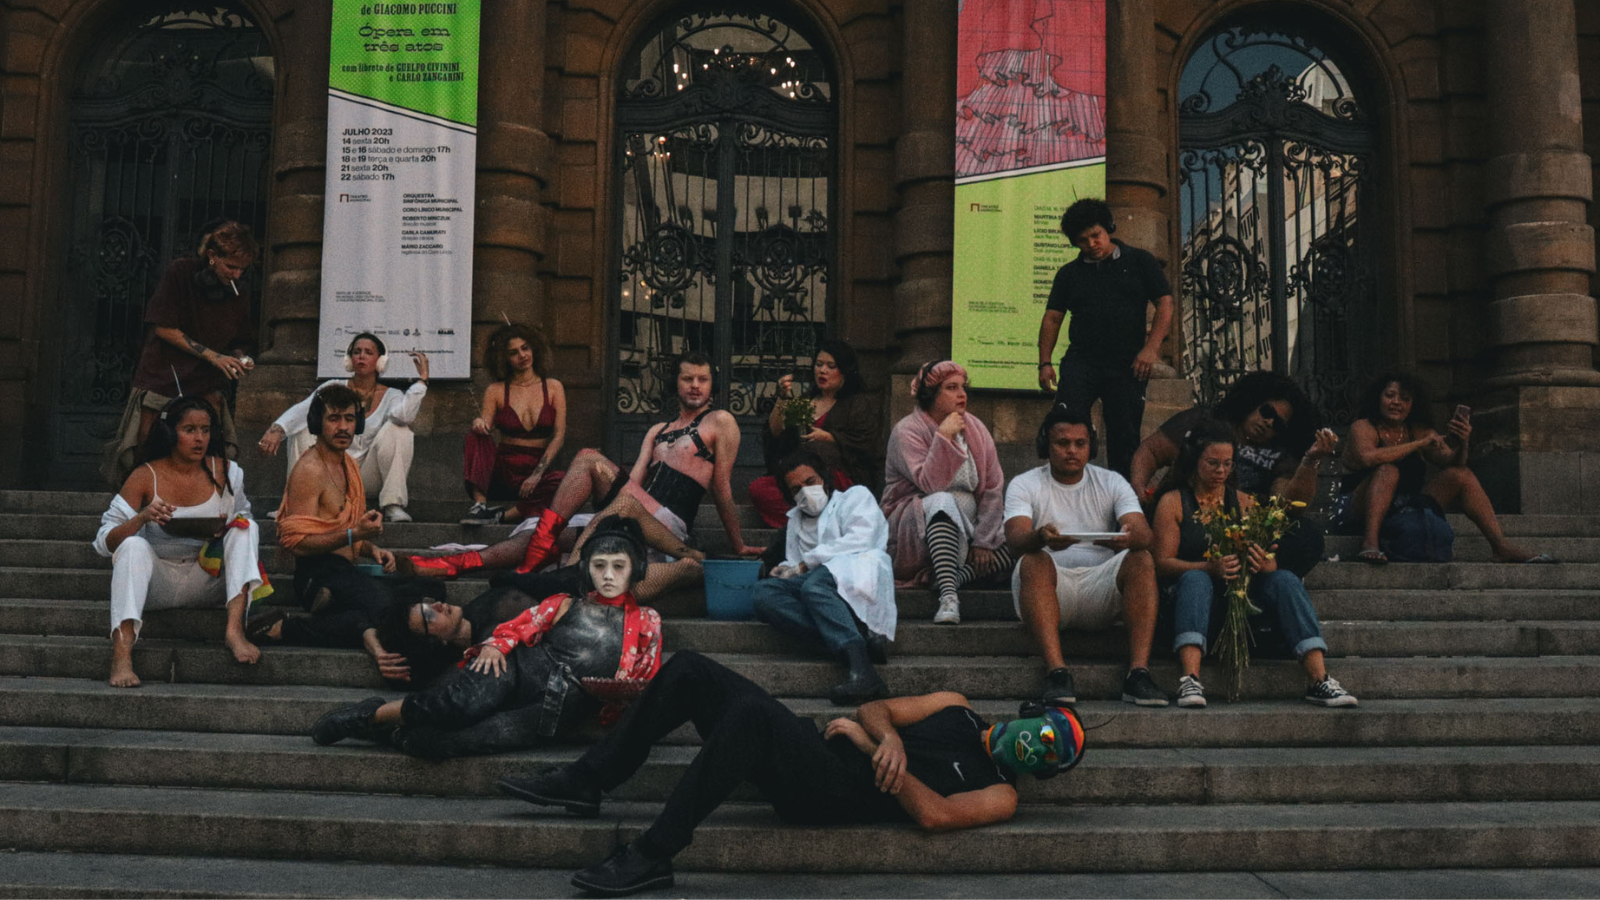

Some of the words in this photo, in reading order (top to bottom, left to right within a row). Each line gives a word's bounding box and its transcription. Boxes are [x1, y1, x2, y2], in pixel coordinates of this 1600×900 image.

[361, 5, 371, 15] de
[374, 3, 416, 15] GIACOMO
[419, 3, 457, 14] PUCCINI
[358, 22, 415, 40] Ópera
[421, 28, 450, 36] em
[364, 41, 399, 52] três
[405, 43, 444, 52] atos
[358, 63, 384, 72] libreto
[386, 63, 394, 72] de
[396, 62, 426, 72] GUELFO
[427, 62, 460, 71] CIVININI
[396, 73, 421, 82] CARLO
[403, 146, 436, 155] domingo
[368, 156, 387, 164] terça
[395, 156, 419, 164] quarta
